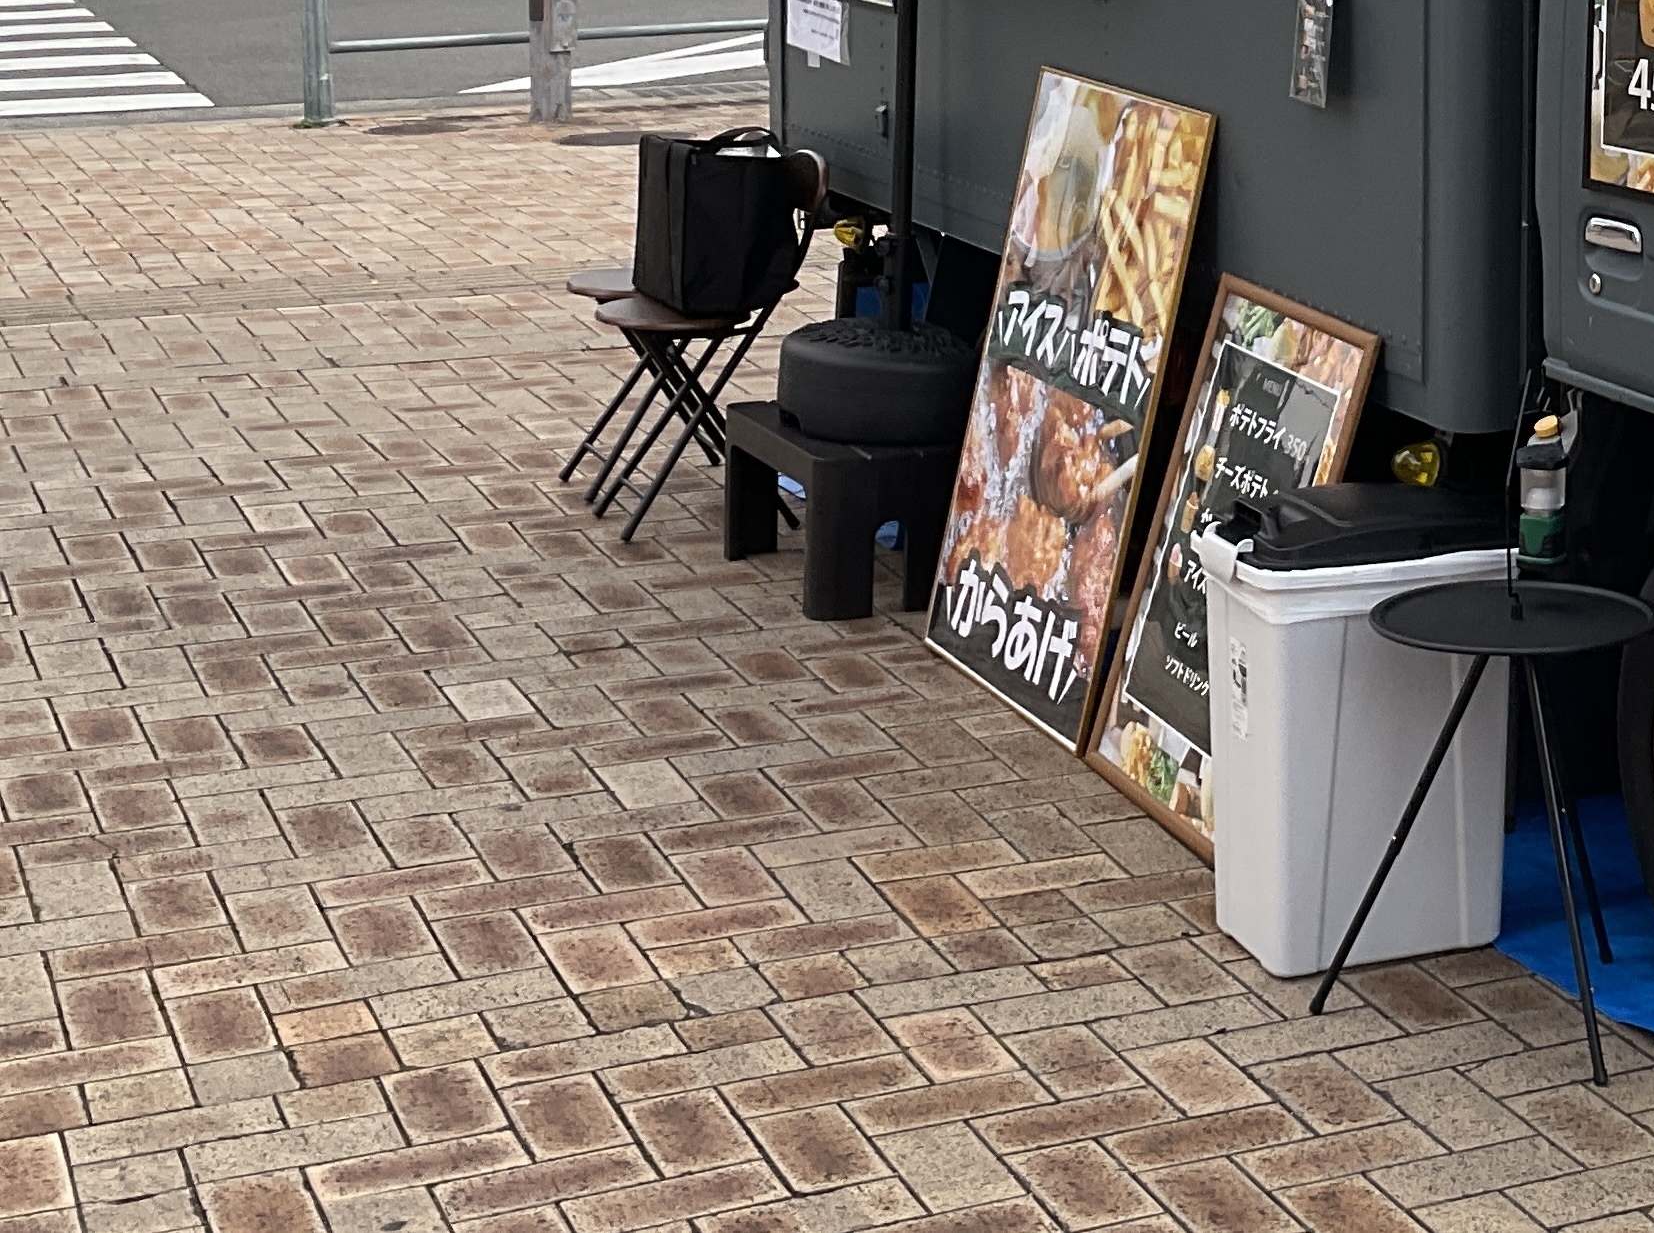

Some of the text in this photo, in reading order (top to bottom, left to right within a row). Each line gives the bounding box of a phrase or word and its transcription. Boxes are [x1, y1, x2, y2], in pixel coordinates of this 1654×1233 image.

[1072, 318, 1147, 405] ポテト
[1229, 403, 1287, 451] ポテトフライ
[1214, 456, 1269, 499] チーズポテト
[950, 558, 1078, 702] からあげ
[1174, 621, 1198, 648] ビール
[1164, 654, 1210, 697] ソフトドリンク
